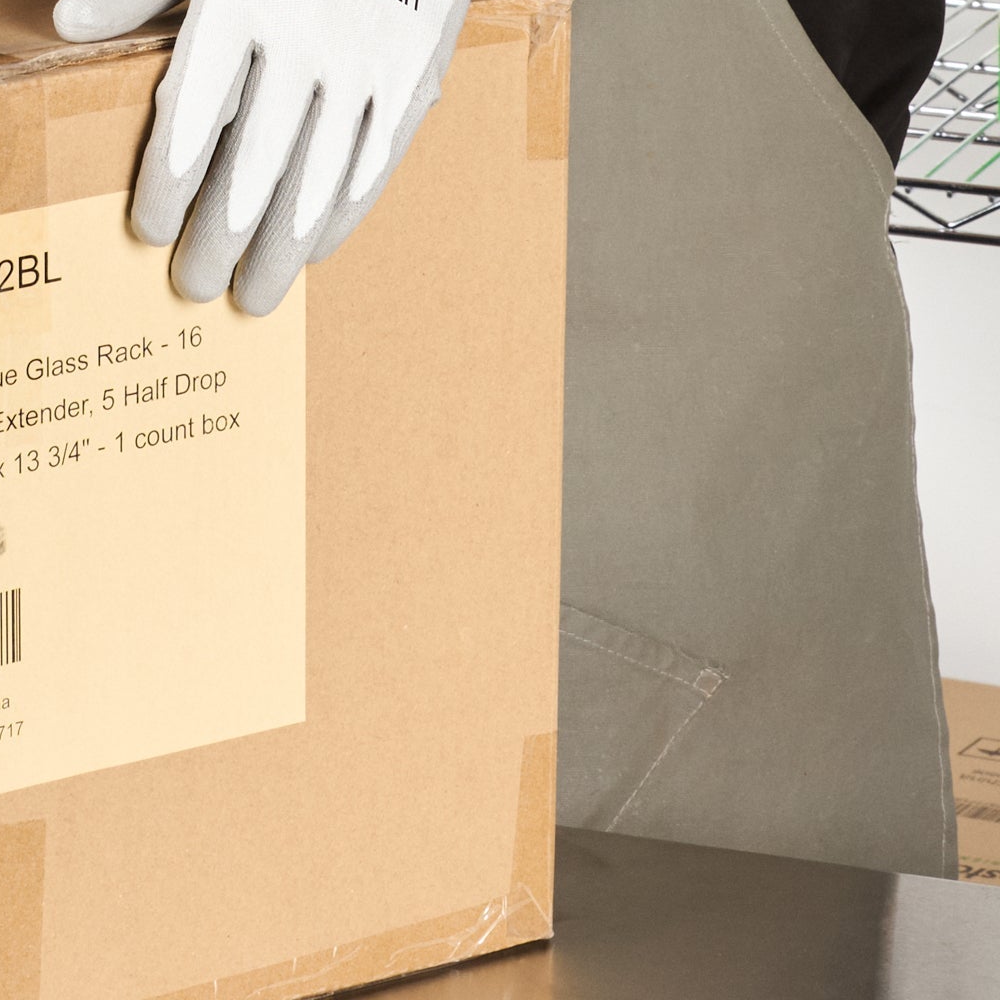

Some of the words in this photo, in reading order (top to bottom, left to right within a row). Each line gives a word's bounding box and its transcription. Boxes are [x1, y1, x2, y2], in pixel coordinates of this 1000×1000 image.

[26, 354, 88, 380] Glass
[98, 337, 153, 367] Rack
[178, 326, 202, 349] 16
[103, 388, 114, 410] 5
[125, 377, 168, 406] Half
[176, 371, 226, 395] Drop
[15, 450, 39, 474] 13
[49, 438, 90, 467] 3/4"
[116, 432, 123, 453] 1
[135, 418, 194, 449] count
[203, 412, 240, 435] box
